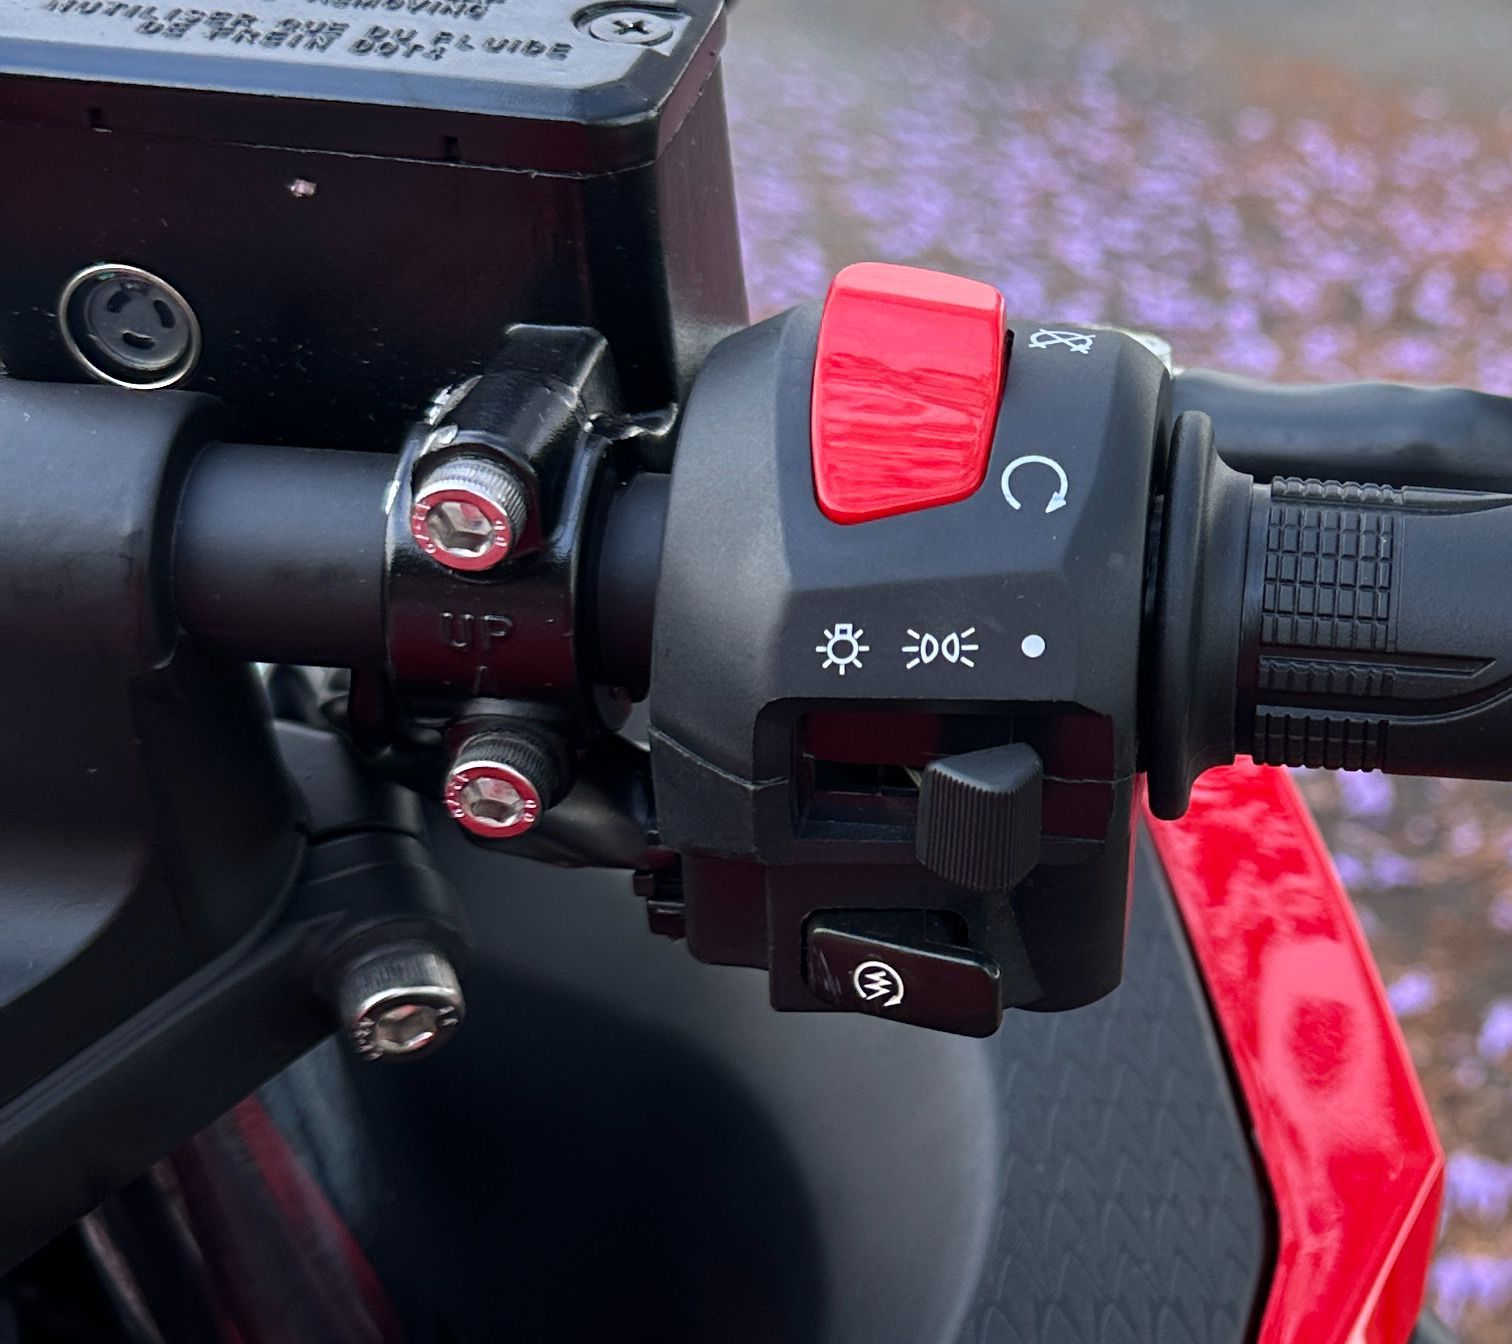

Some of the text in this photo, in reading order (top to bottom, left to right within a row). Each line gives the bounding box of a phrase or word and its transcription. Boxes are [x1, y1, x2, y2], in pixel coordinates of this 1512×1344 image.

[136, 21, 446, 61] DE FREIN DOT4
[276, 16, 351, 32] QUE
[362, 23, 417, 41] DU
[431, 29, 574, 60] FLUIDE
[439, 611, 514, 652] UP
